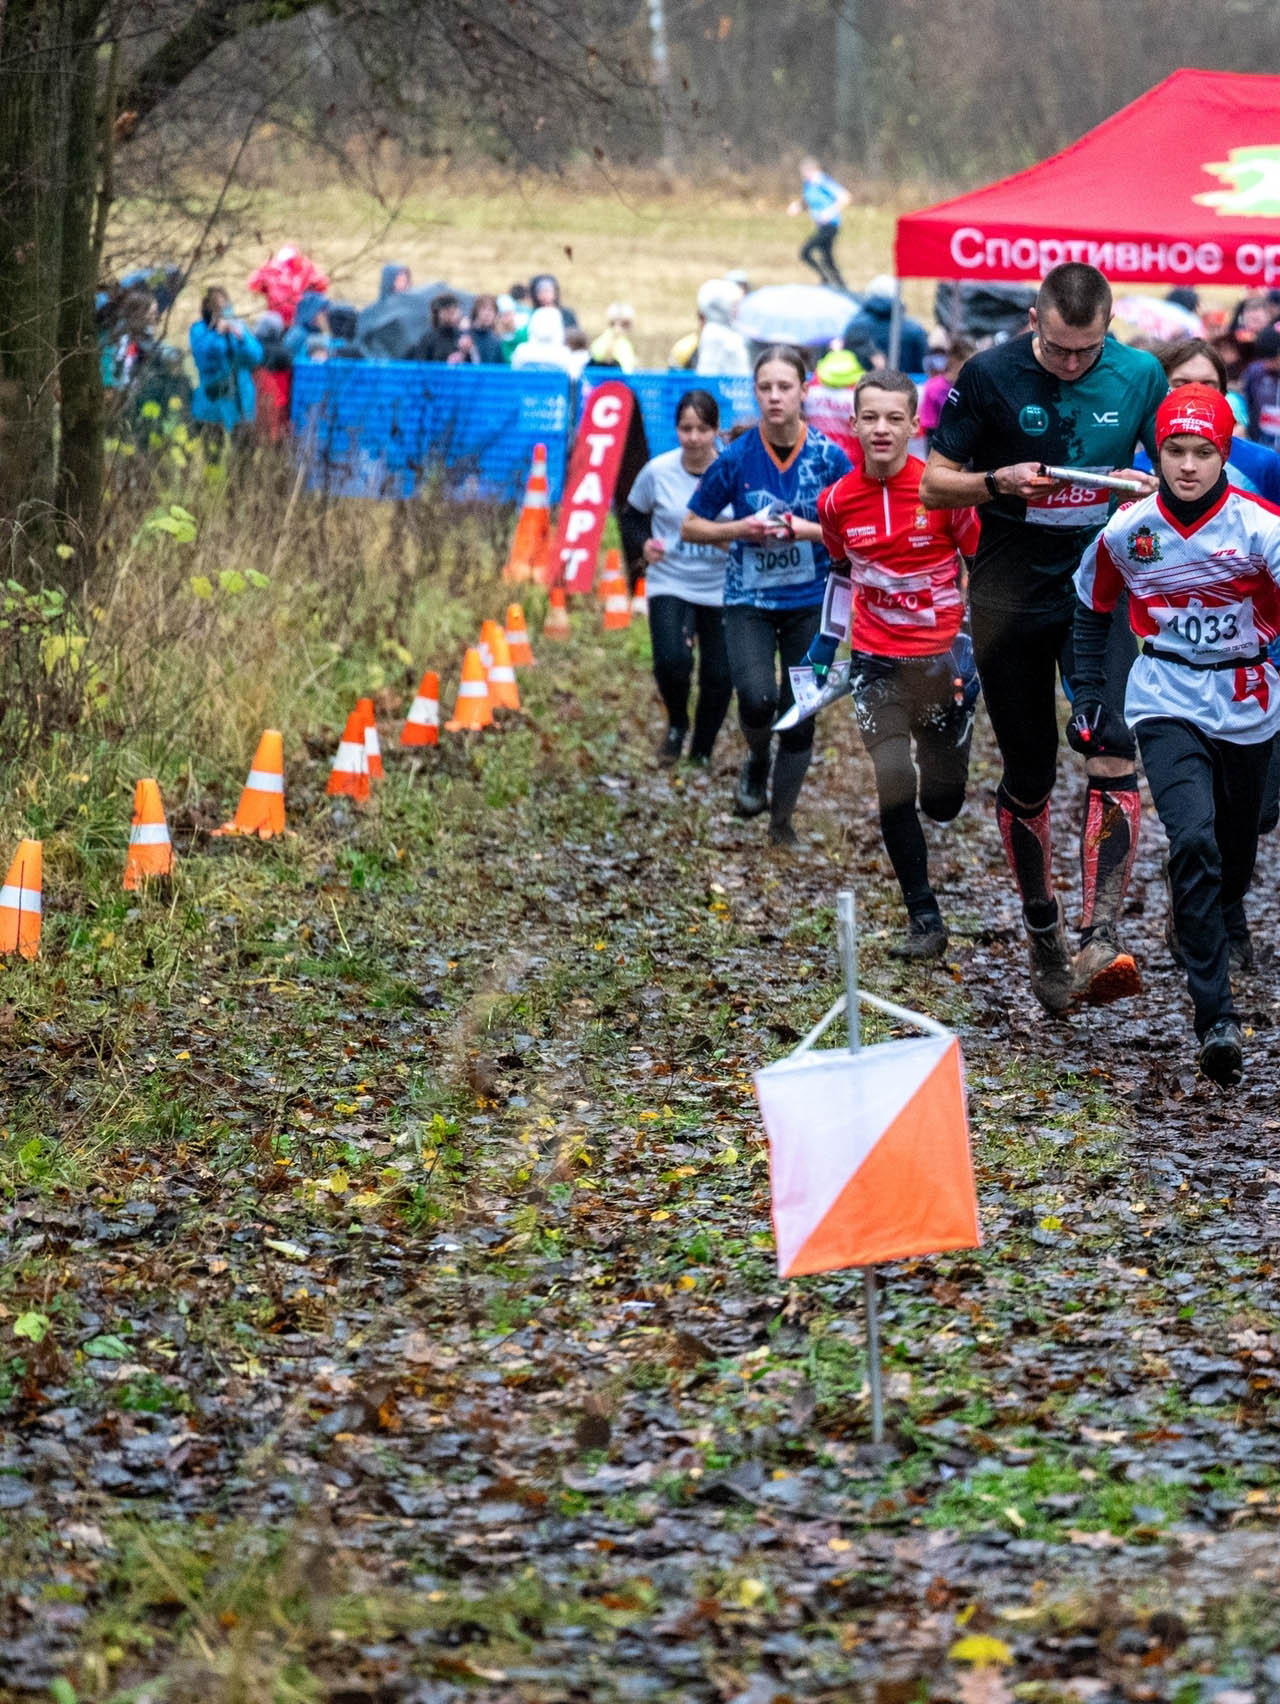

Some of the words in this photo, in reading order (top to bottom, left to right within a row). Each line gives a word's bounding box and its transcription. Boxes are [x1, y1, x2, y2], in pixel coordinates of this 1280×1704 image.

[951, 228, 1223, 277] Спортивное
[560, 396, 622, 580] СТАРТ
[1168, 614, 1238, 645] 1033
